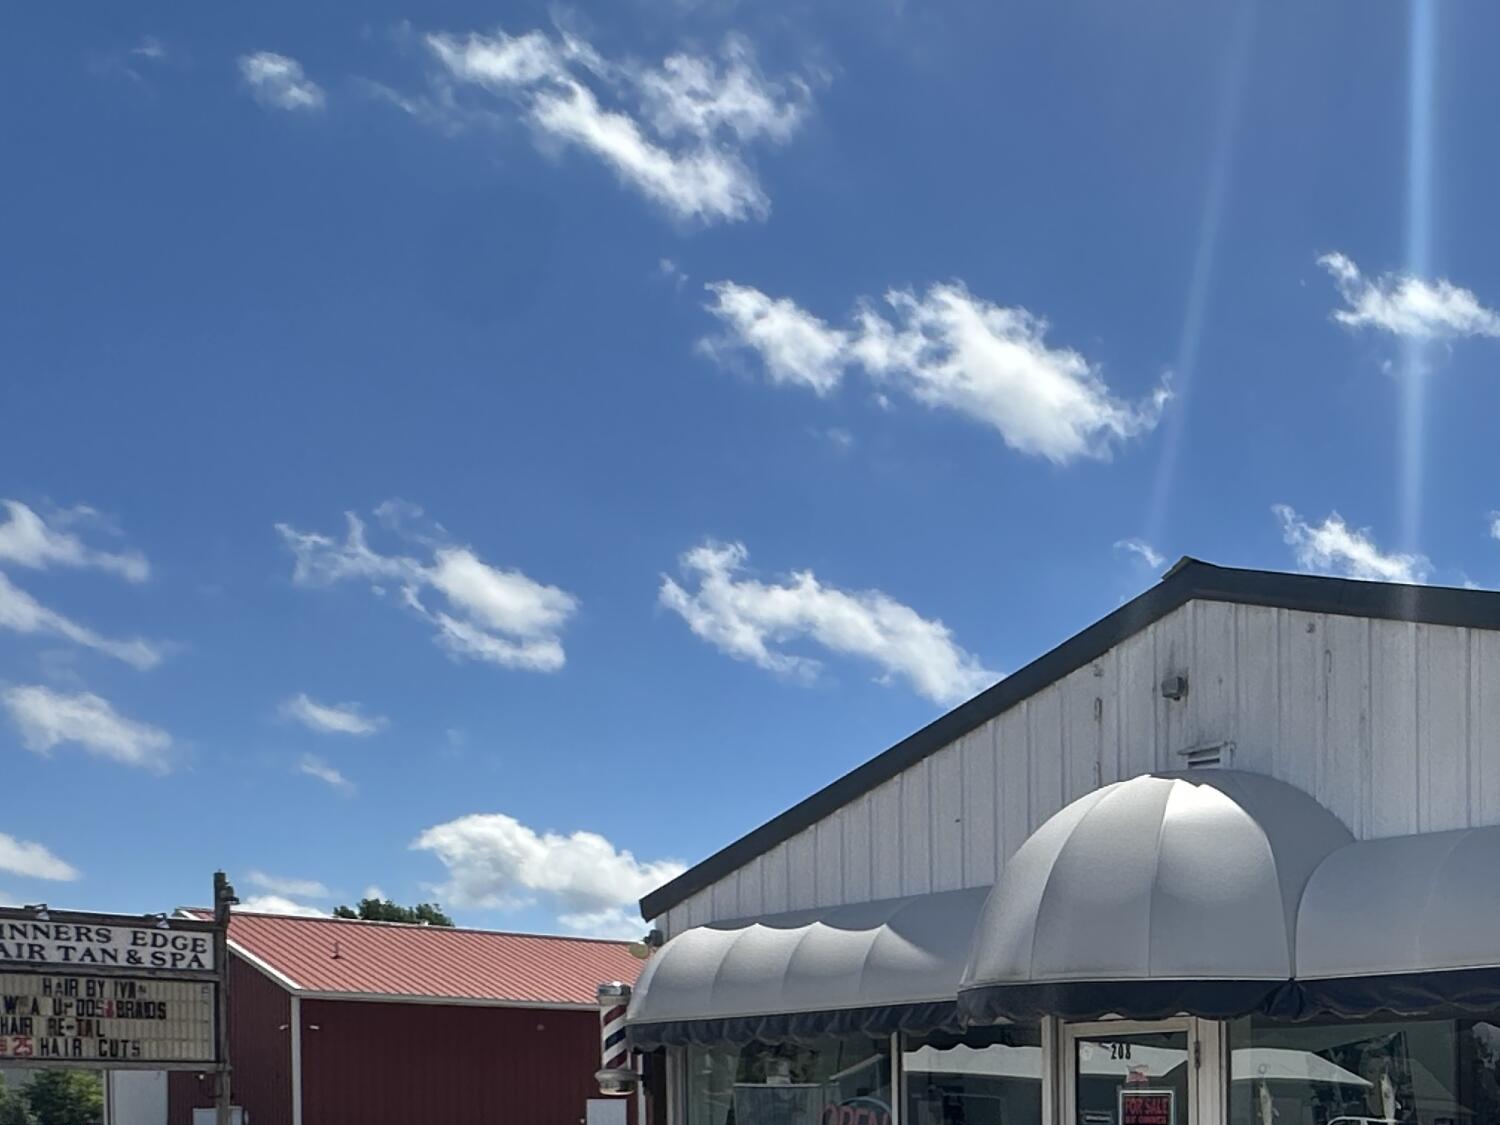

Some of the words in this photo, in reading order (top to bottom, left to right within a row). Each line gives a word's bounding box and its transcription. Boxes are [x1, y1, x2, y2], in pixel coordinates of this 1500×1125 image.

[131, 930, 207, 953] EDGE
[57, 945, 118, 963] TAN
[126, 949, 144, 965] &
[151, 951, 205, 969] SPA
[43, 977, 78, 998] HAIR
[86, 979, 104, 998] BY
[40, 1037, 82, 1057] HAIR
[99, 1039, 141, 1058] CUTS
[1110, 1042, 1131, 1060] 208
[1125, 1097, 1143, 1114] FOR
[1144, 1097, 1168, 1115] SALE
